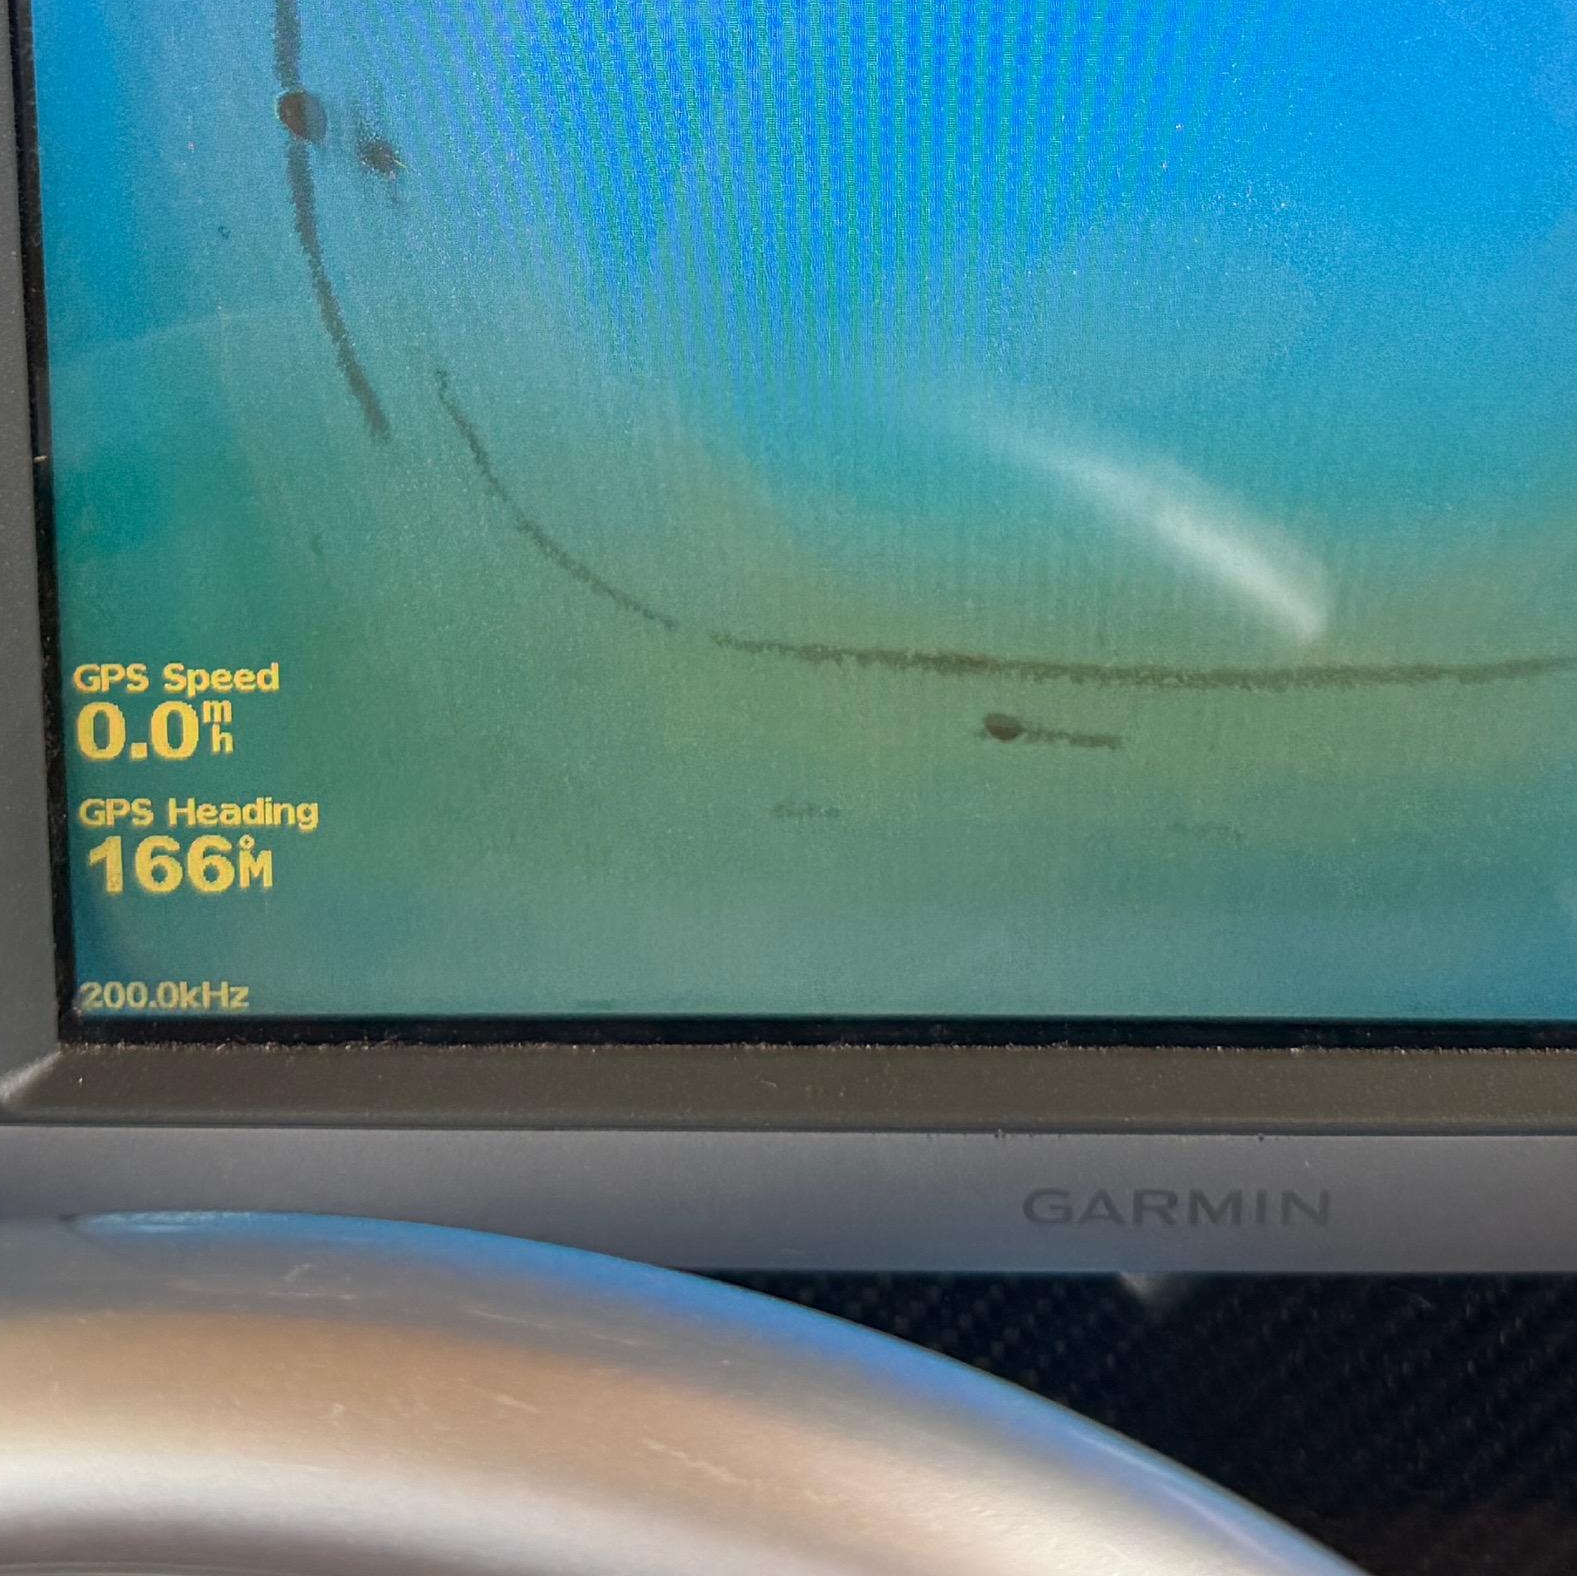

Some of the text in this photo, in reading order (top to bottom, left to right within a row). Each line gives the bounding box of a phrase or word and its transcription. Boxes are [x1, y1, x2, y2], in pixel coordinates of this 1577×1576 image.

[73, 662, 280, 697] GPS Speed
[79, 797, 319, 832] GPS Heading
[79, 981, 250, 1010] 200.0kHz
[1022, 1187, 1331, 1225] GARMIN
